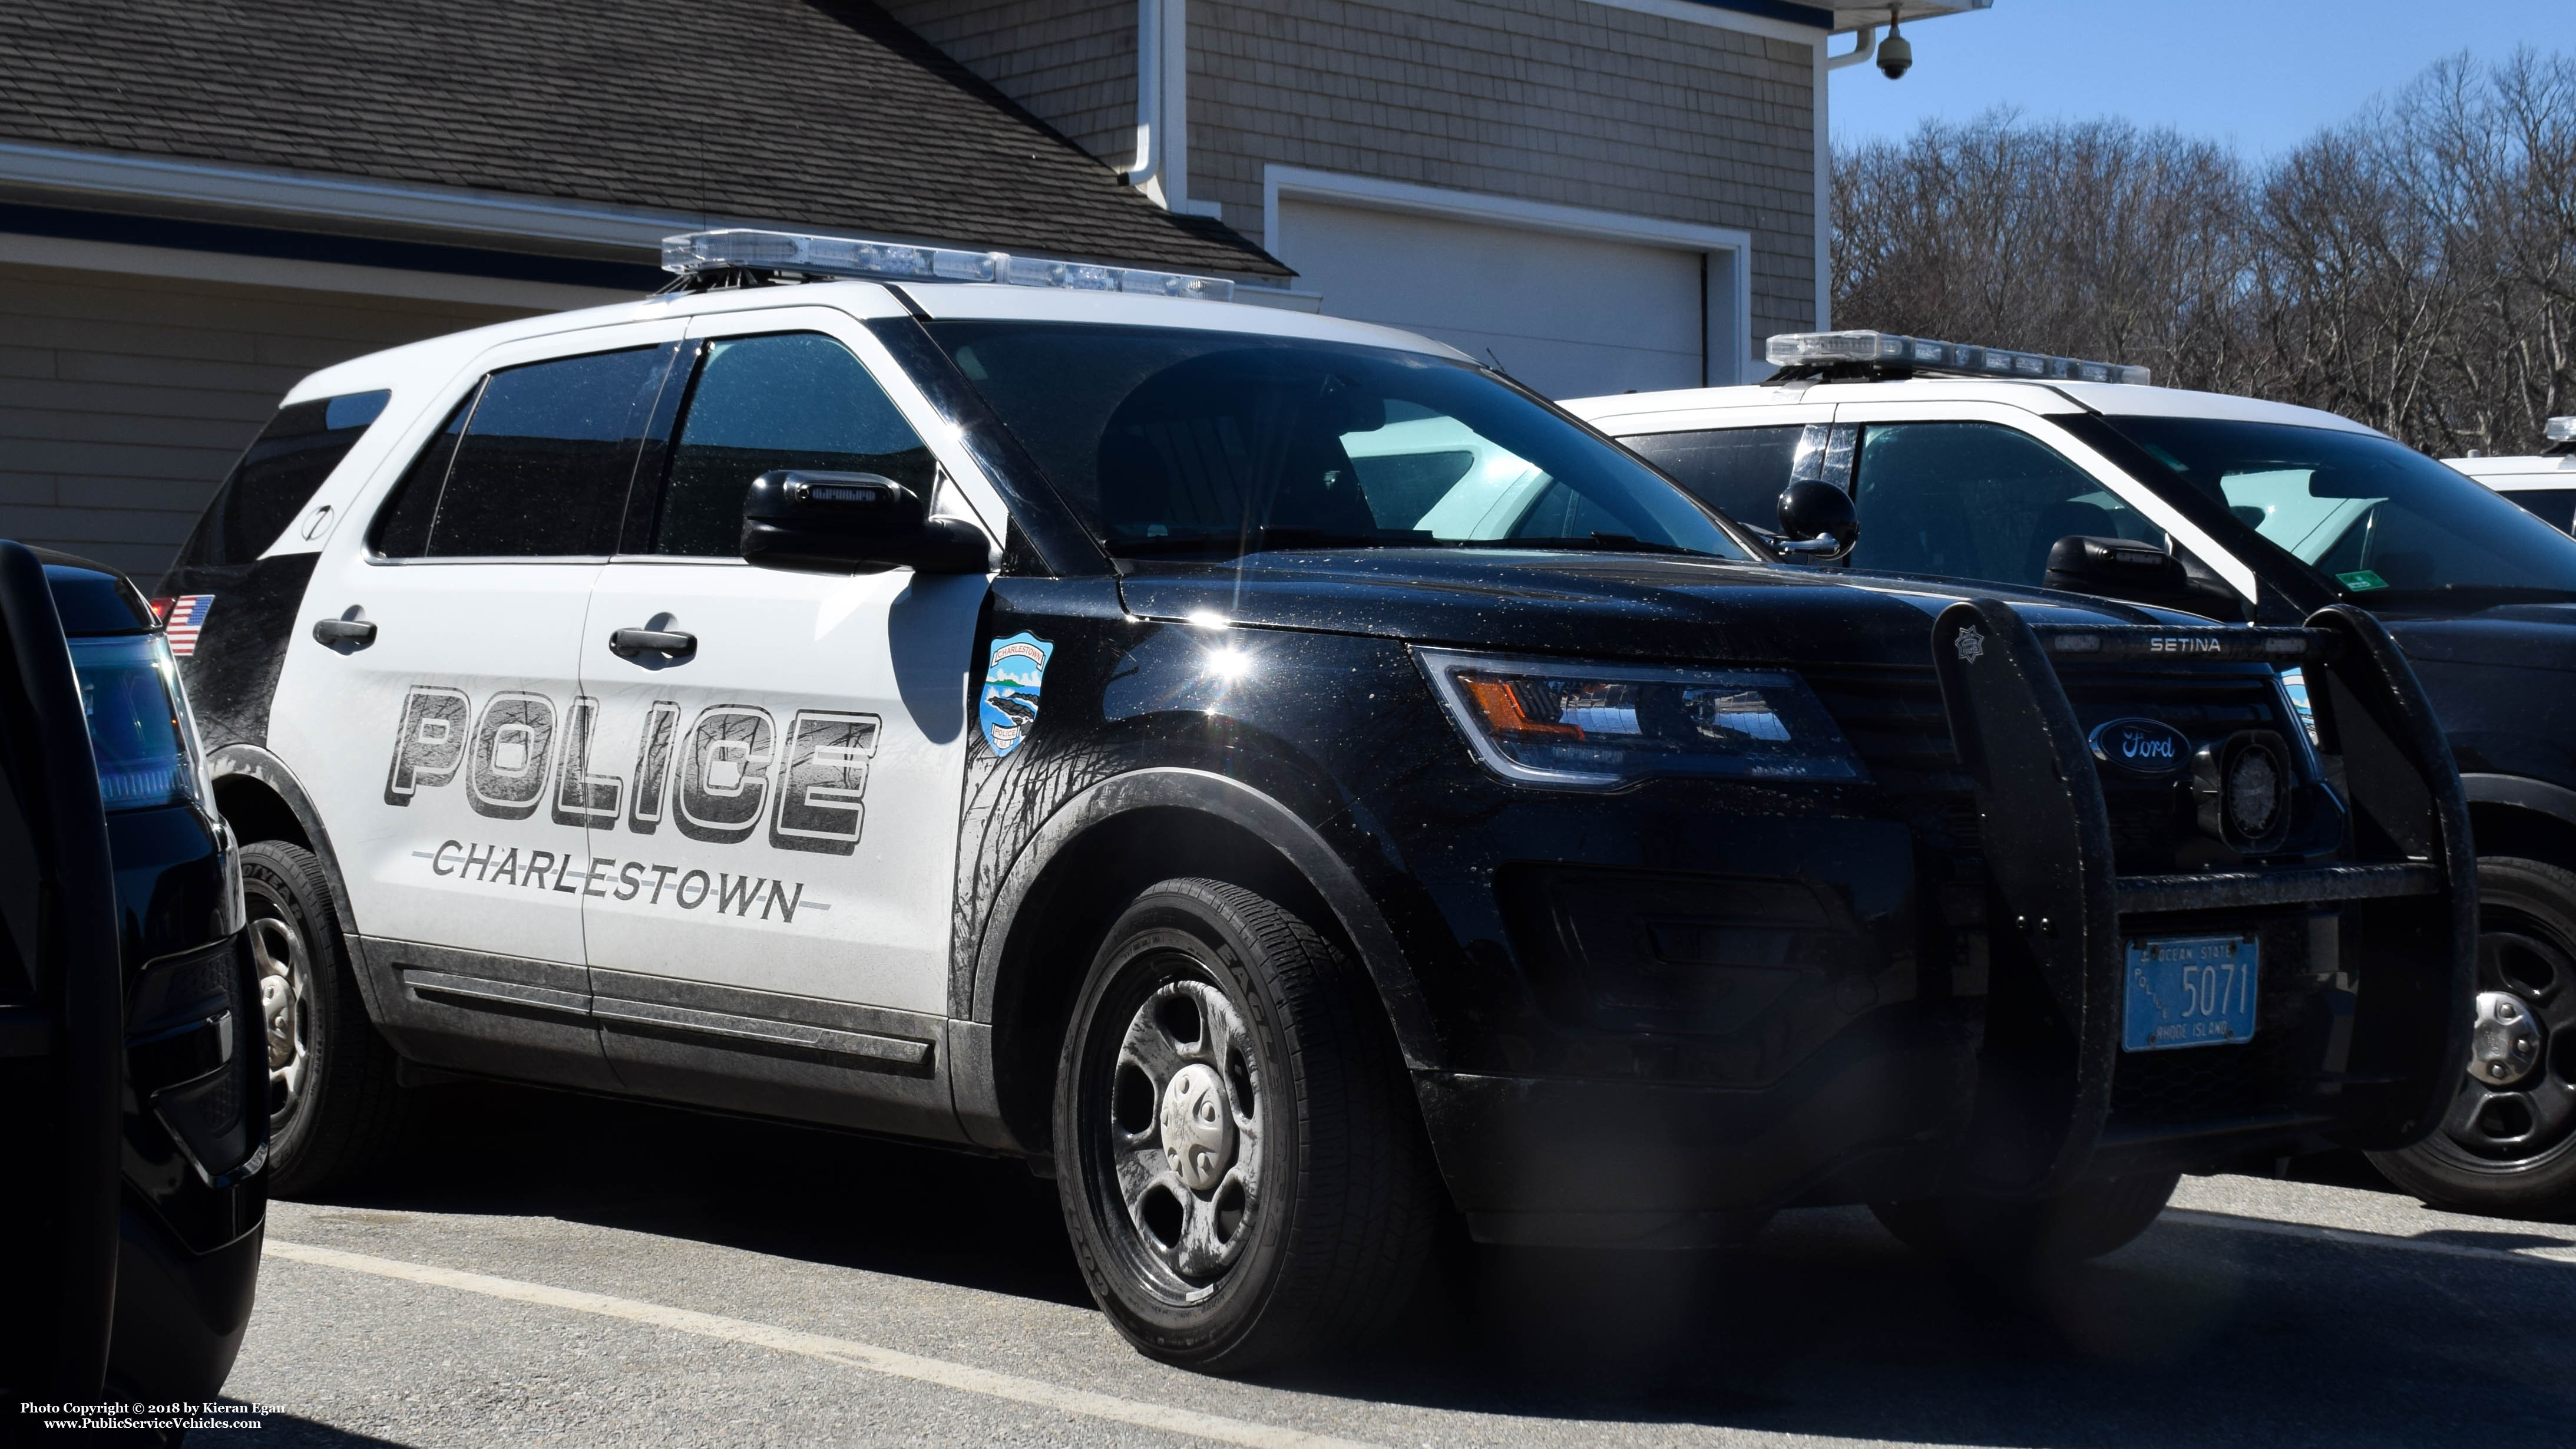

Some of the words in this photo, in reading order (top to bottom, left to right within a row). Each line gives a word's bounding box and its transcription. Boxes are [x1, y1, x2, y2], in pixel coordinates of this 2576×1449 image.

[998, 645, 1041, 661] CHARLESTOWN
[2150, 638, 2221, 652] SETINA
[995, 728, 1016, 737] POLICE
[2122, 727, 2175, 758] Ford
[384, 685, 882, 856] POLICE
[432, 840, 804, 923] CHARLESTOWN
[2159, 949, 2193, 962] OCEAN
[2200, 945, 2230, 959] STATE
[2181, 963, 2247, 1018] 5071
[2156, 1024, 2187, 1040] RHODE
[2193, 1021, 2228, 1037] ISLAND
